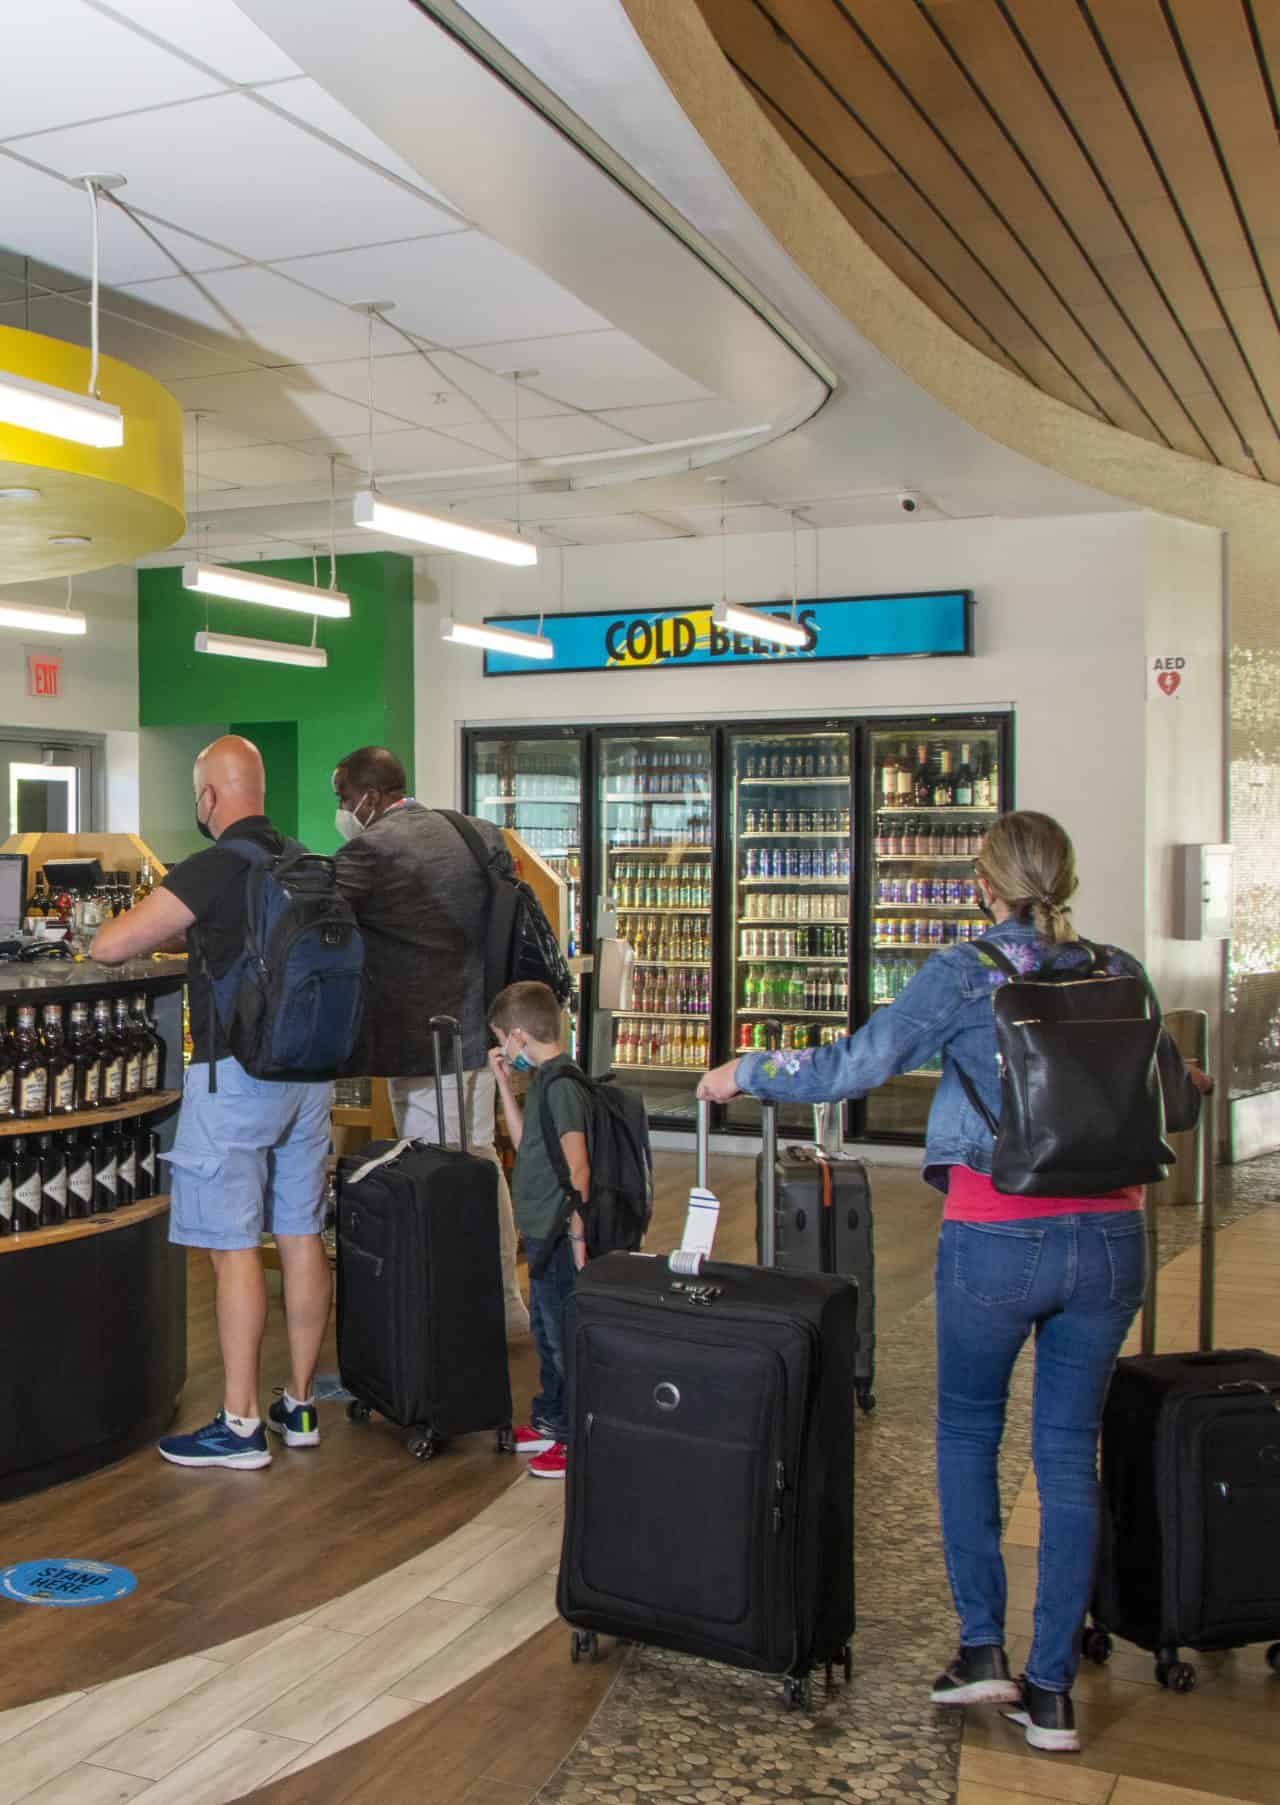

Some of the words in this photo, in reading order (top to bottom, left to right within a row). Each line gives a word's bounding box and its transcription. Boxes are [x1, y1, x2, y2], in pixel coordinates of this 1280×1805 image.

[605, 617, 696, 660] COLD
[1154, 657, 1186, 670] AED
[34, 663, 58, 697] EXIT
[30, 1577, 89, 1594] HERE
[38, 1567, 110, 1586] STAND
